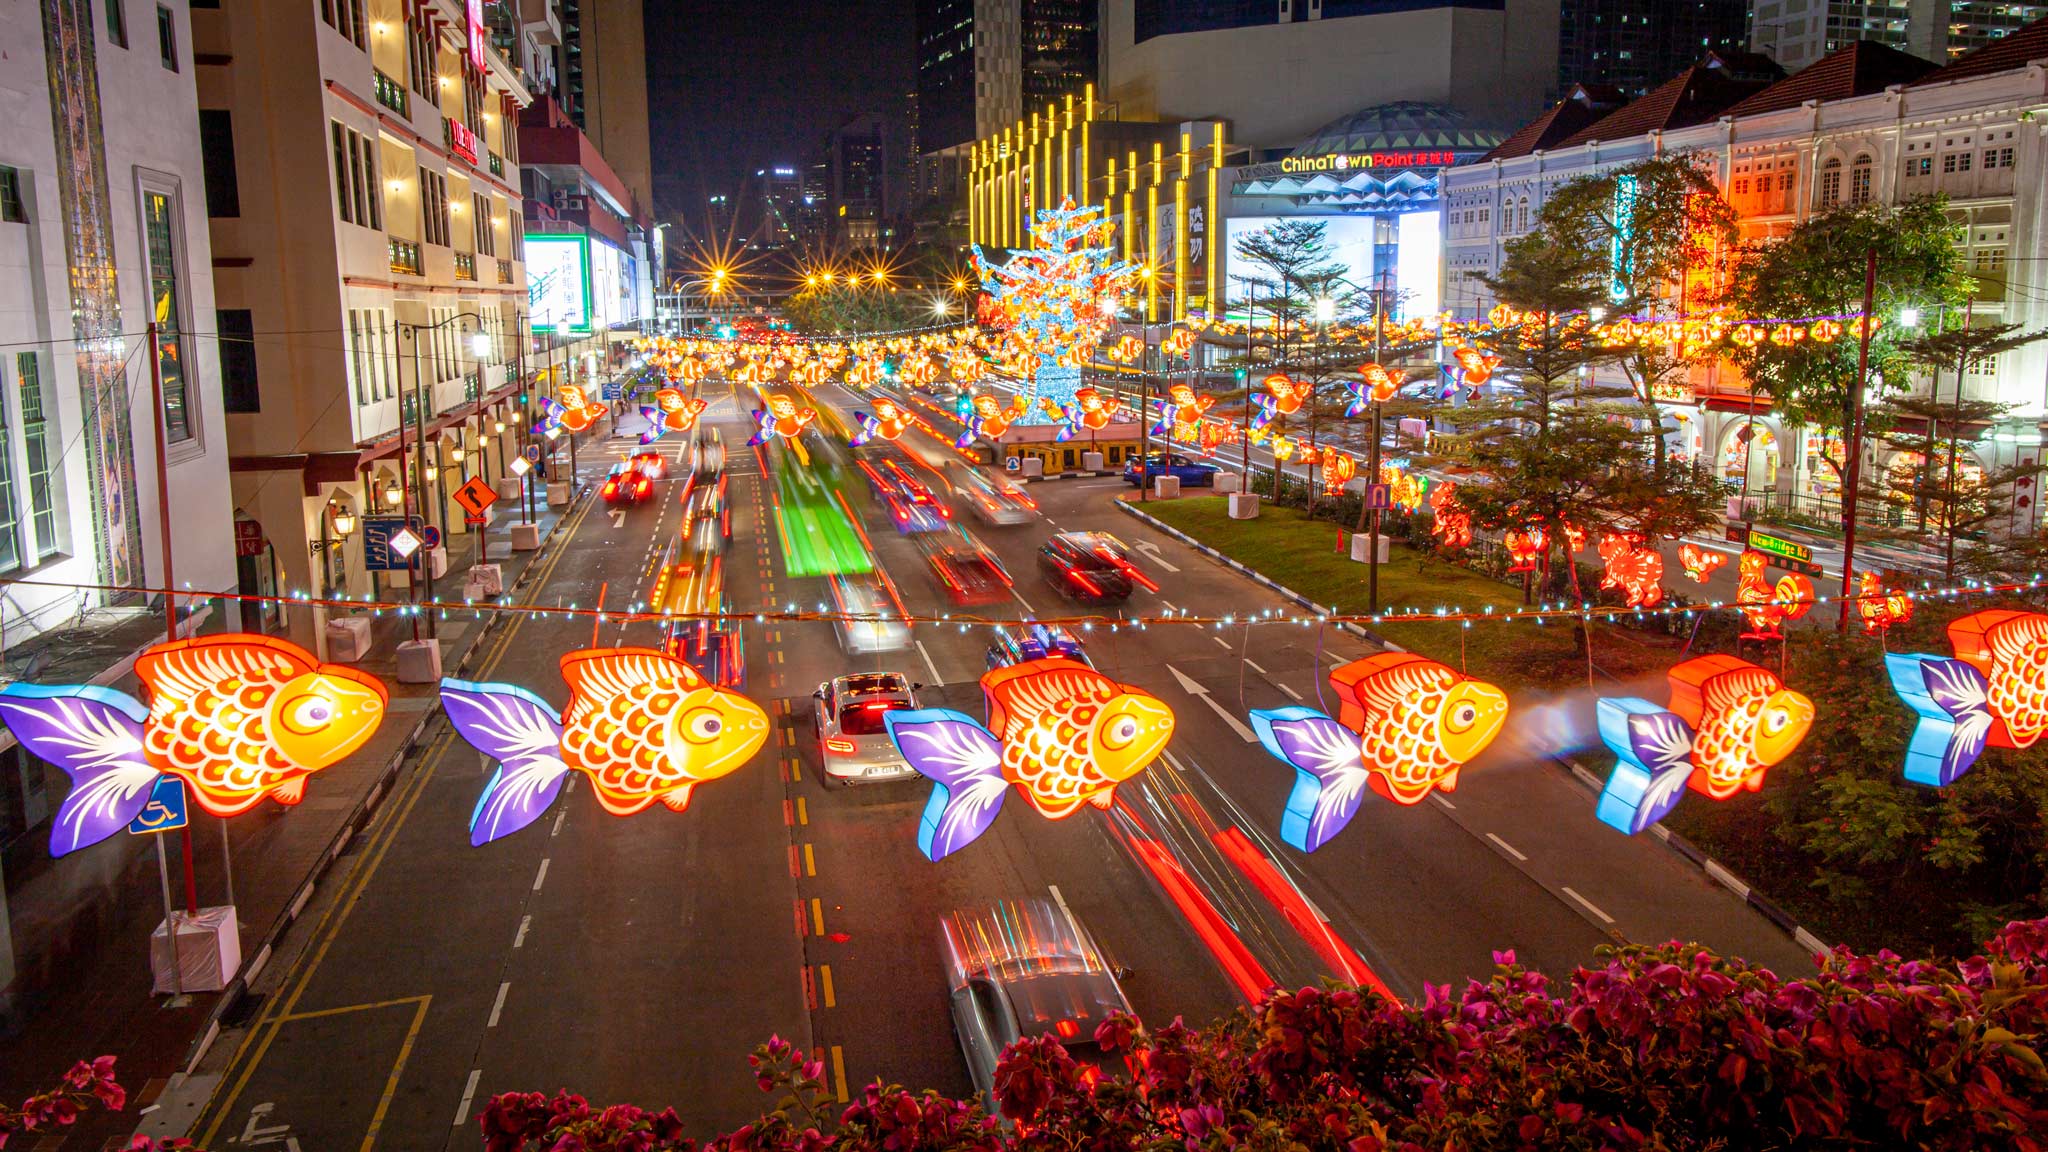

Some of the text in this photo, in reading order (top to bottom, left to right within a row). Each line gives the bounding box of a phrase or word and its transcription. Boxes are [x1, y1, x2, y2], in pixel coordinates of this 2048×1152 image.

[1752, 532, 1808, 559] New Bridge Rd
